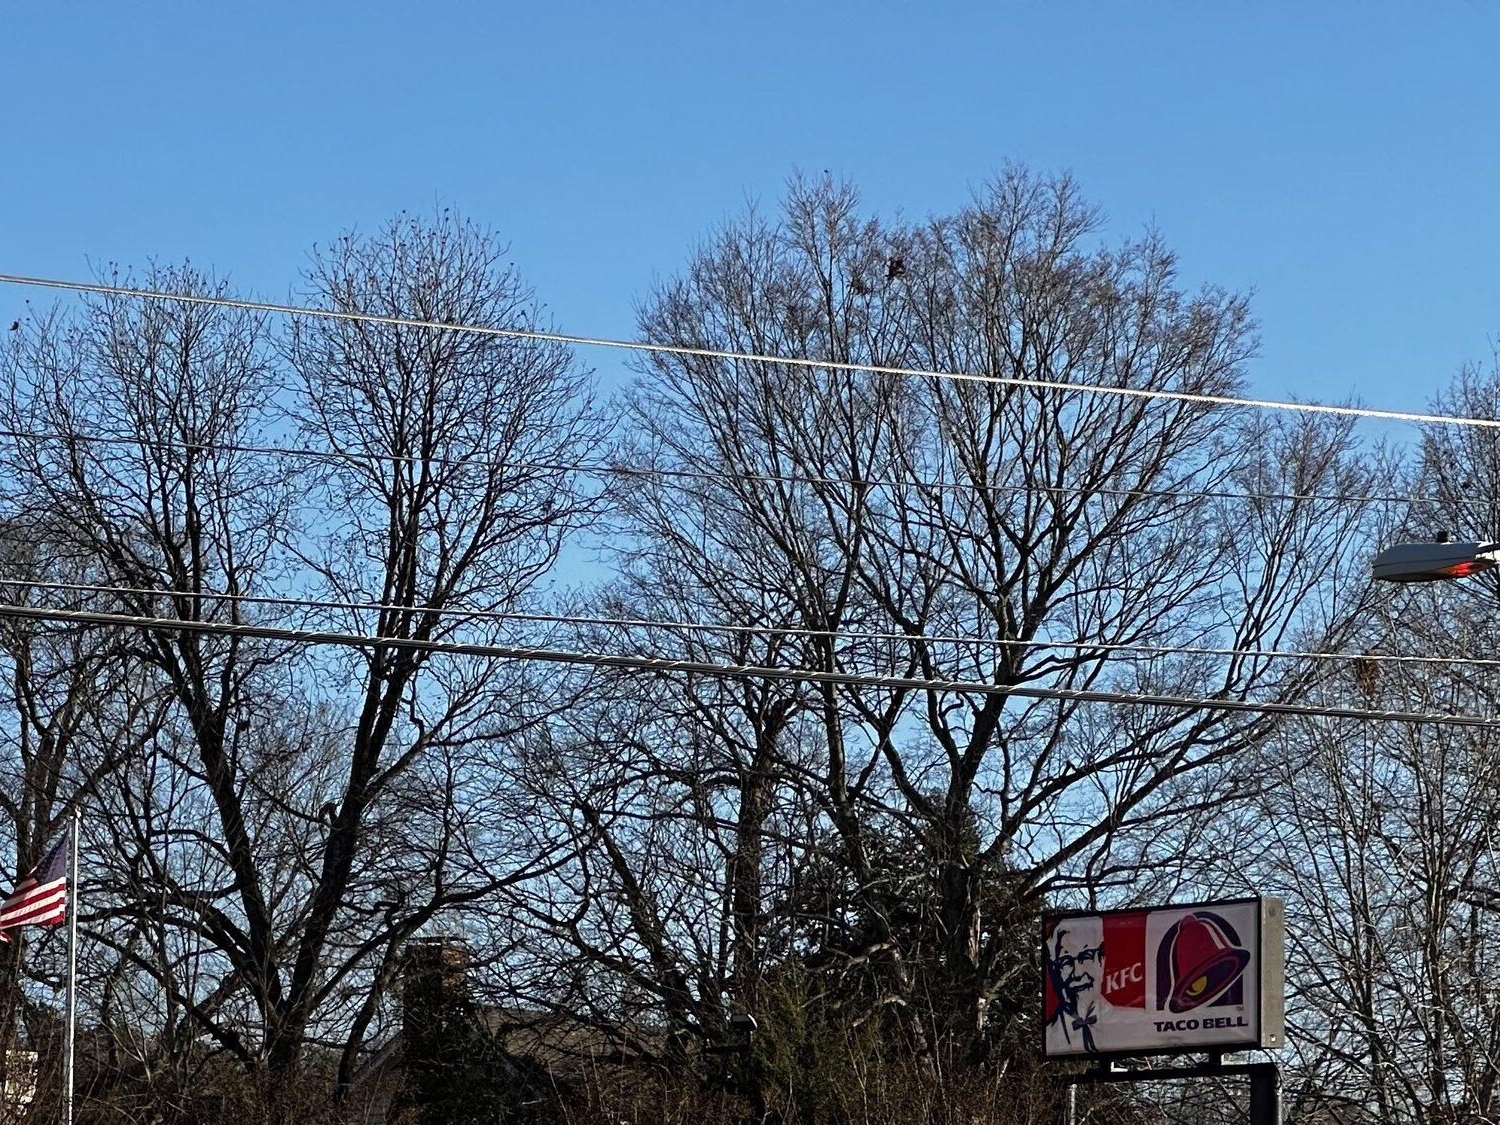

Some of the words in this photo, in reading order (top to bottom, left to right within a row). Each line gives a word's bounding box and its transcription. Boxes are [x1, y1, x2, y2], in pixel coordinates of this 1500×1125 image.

[1105, 962, 1143, 995] KFC
[1153, 1018, 1200, 1033] TACO
[1202, 1015, 1249, 1030] BELL
